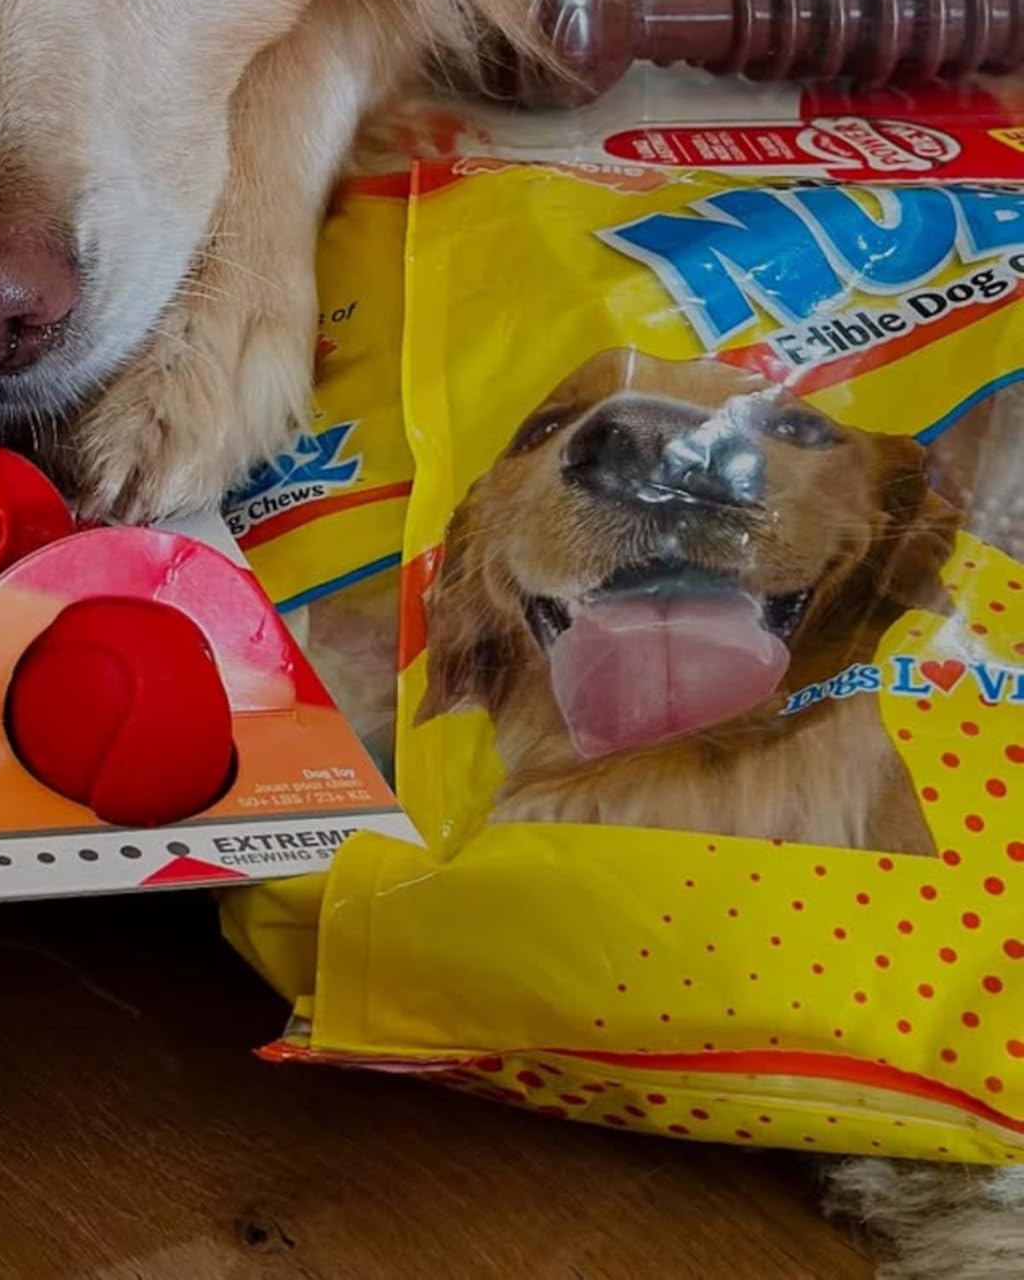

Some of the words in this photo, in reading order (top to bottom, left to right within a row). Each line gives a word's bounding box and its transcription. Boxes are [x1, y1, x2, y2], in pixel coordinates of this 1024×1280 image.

[330, 301, 357, 322] of
[907, 269, 1009, 318] Dog
[248, 483, 326, 521] Chews
[782, 664, 882, 713] Dogs
[220, 851, 311, 866] CHEWING
